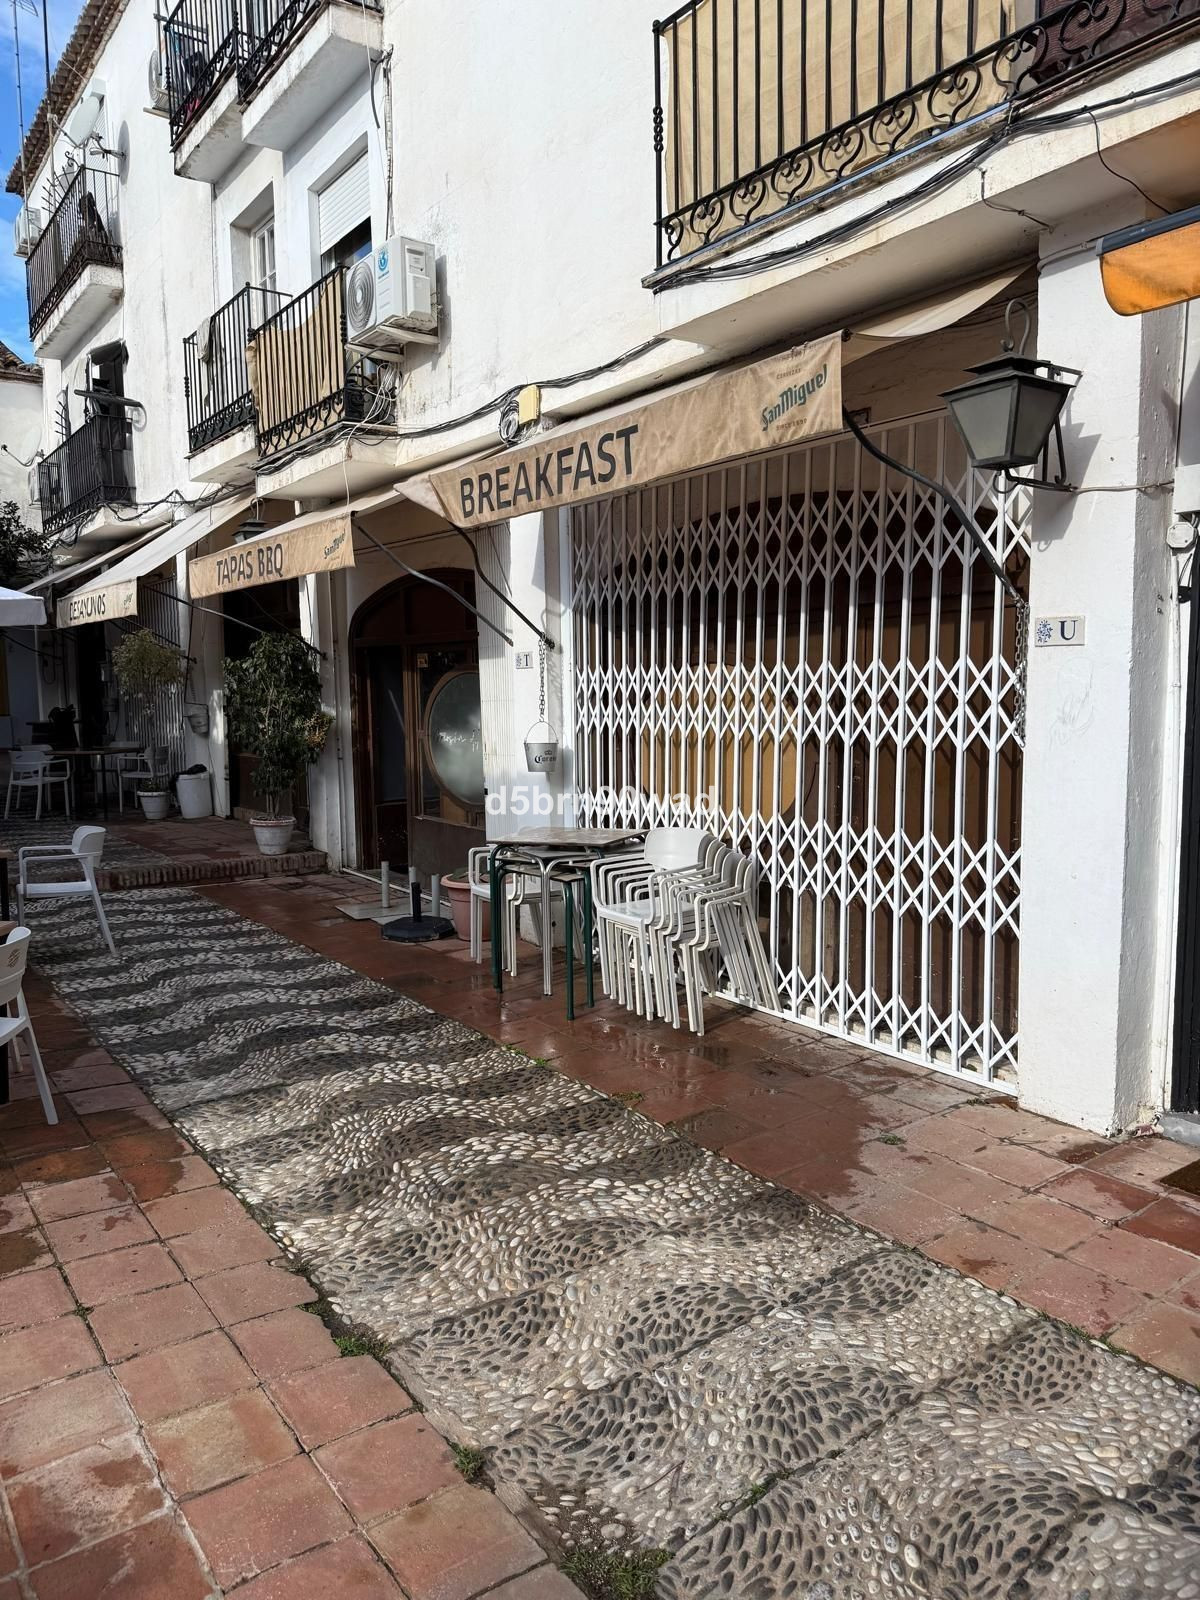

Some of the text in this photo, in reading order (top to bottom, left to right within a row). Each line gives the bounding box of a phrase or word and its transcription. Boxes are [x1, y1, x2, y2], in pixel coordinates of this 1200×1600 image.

[460, 424, 639, 519] BREAKFAST
[216, 543, 283, 586] TAPAS BBQ
[69, 593, 106, 621] DESAYUNOS
[1059, 619, 1079, 641] U
